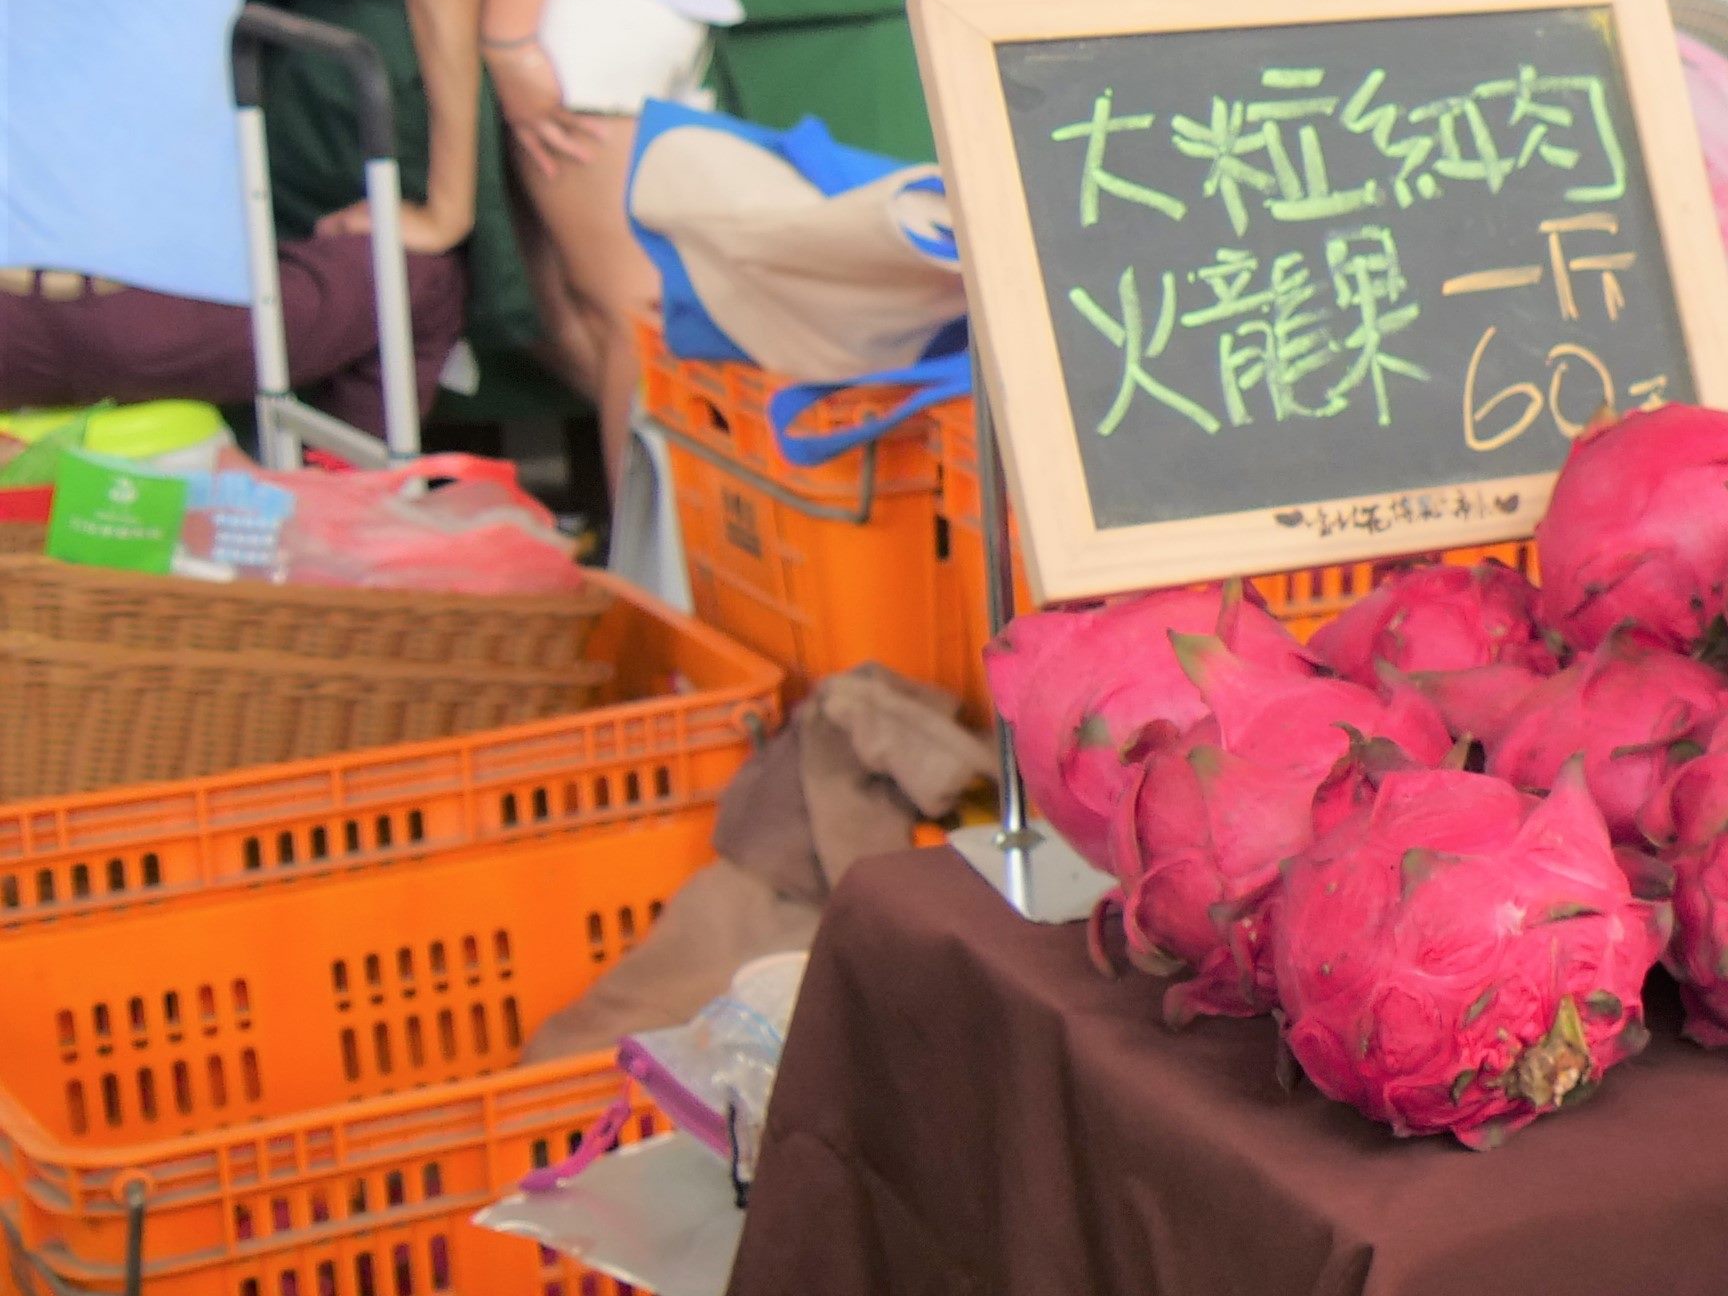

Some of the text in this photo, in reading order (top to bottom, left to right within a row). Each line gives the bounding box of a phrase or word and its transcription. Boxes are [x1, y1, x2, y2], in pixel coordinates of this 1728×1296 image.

[1052, 64, 1625, 235] 大粒紅肉
[1069, 213, 1636, 436] 火龍果 一斤
